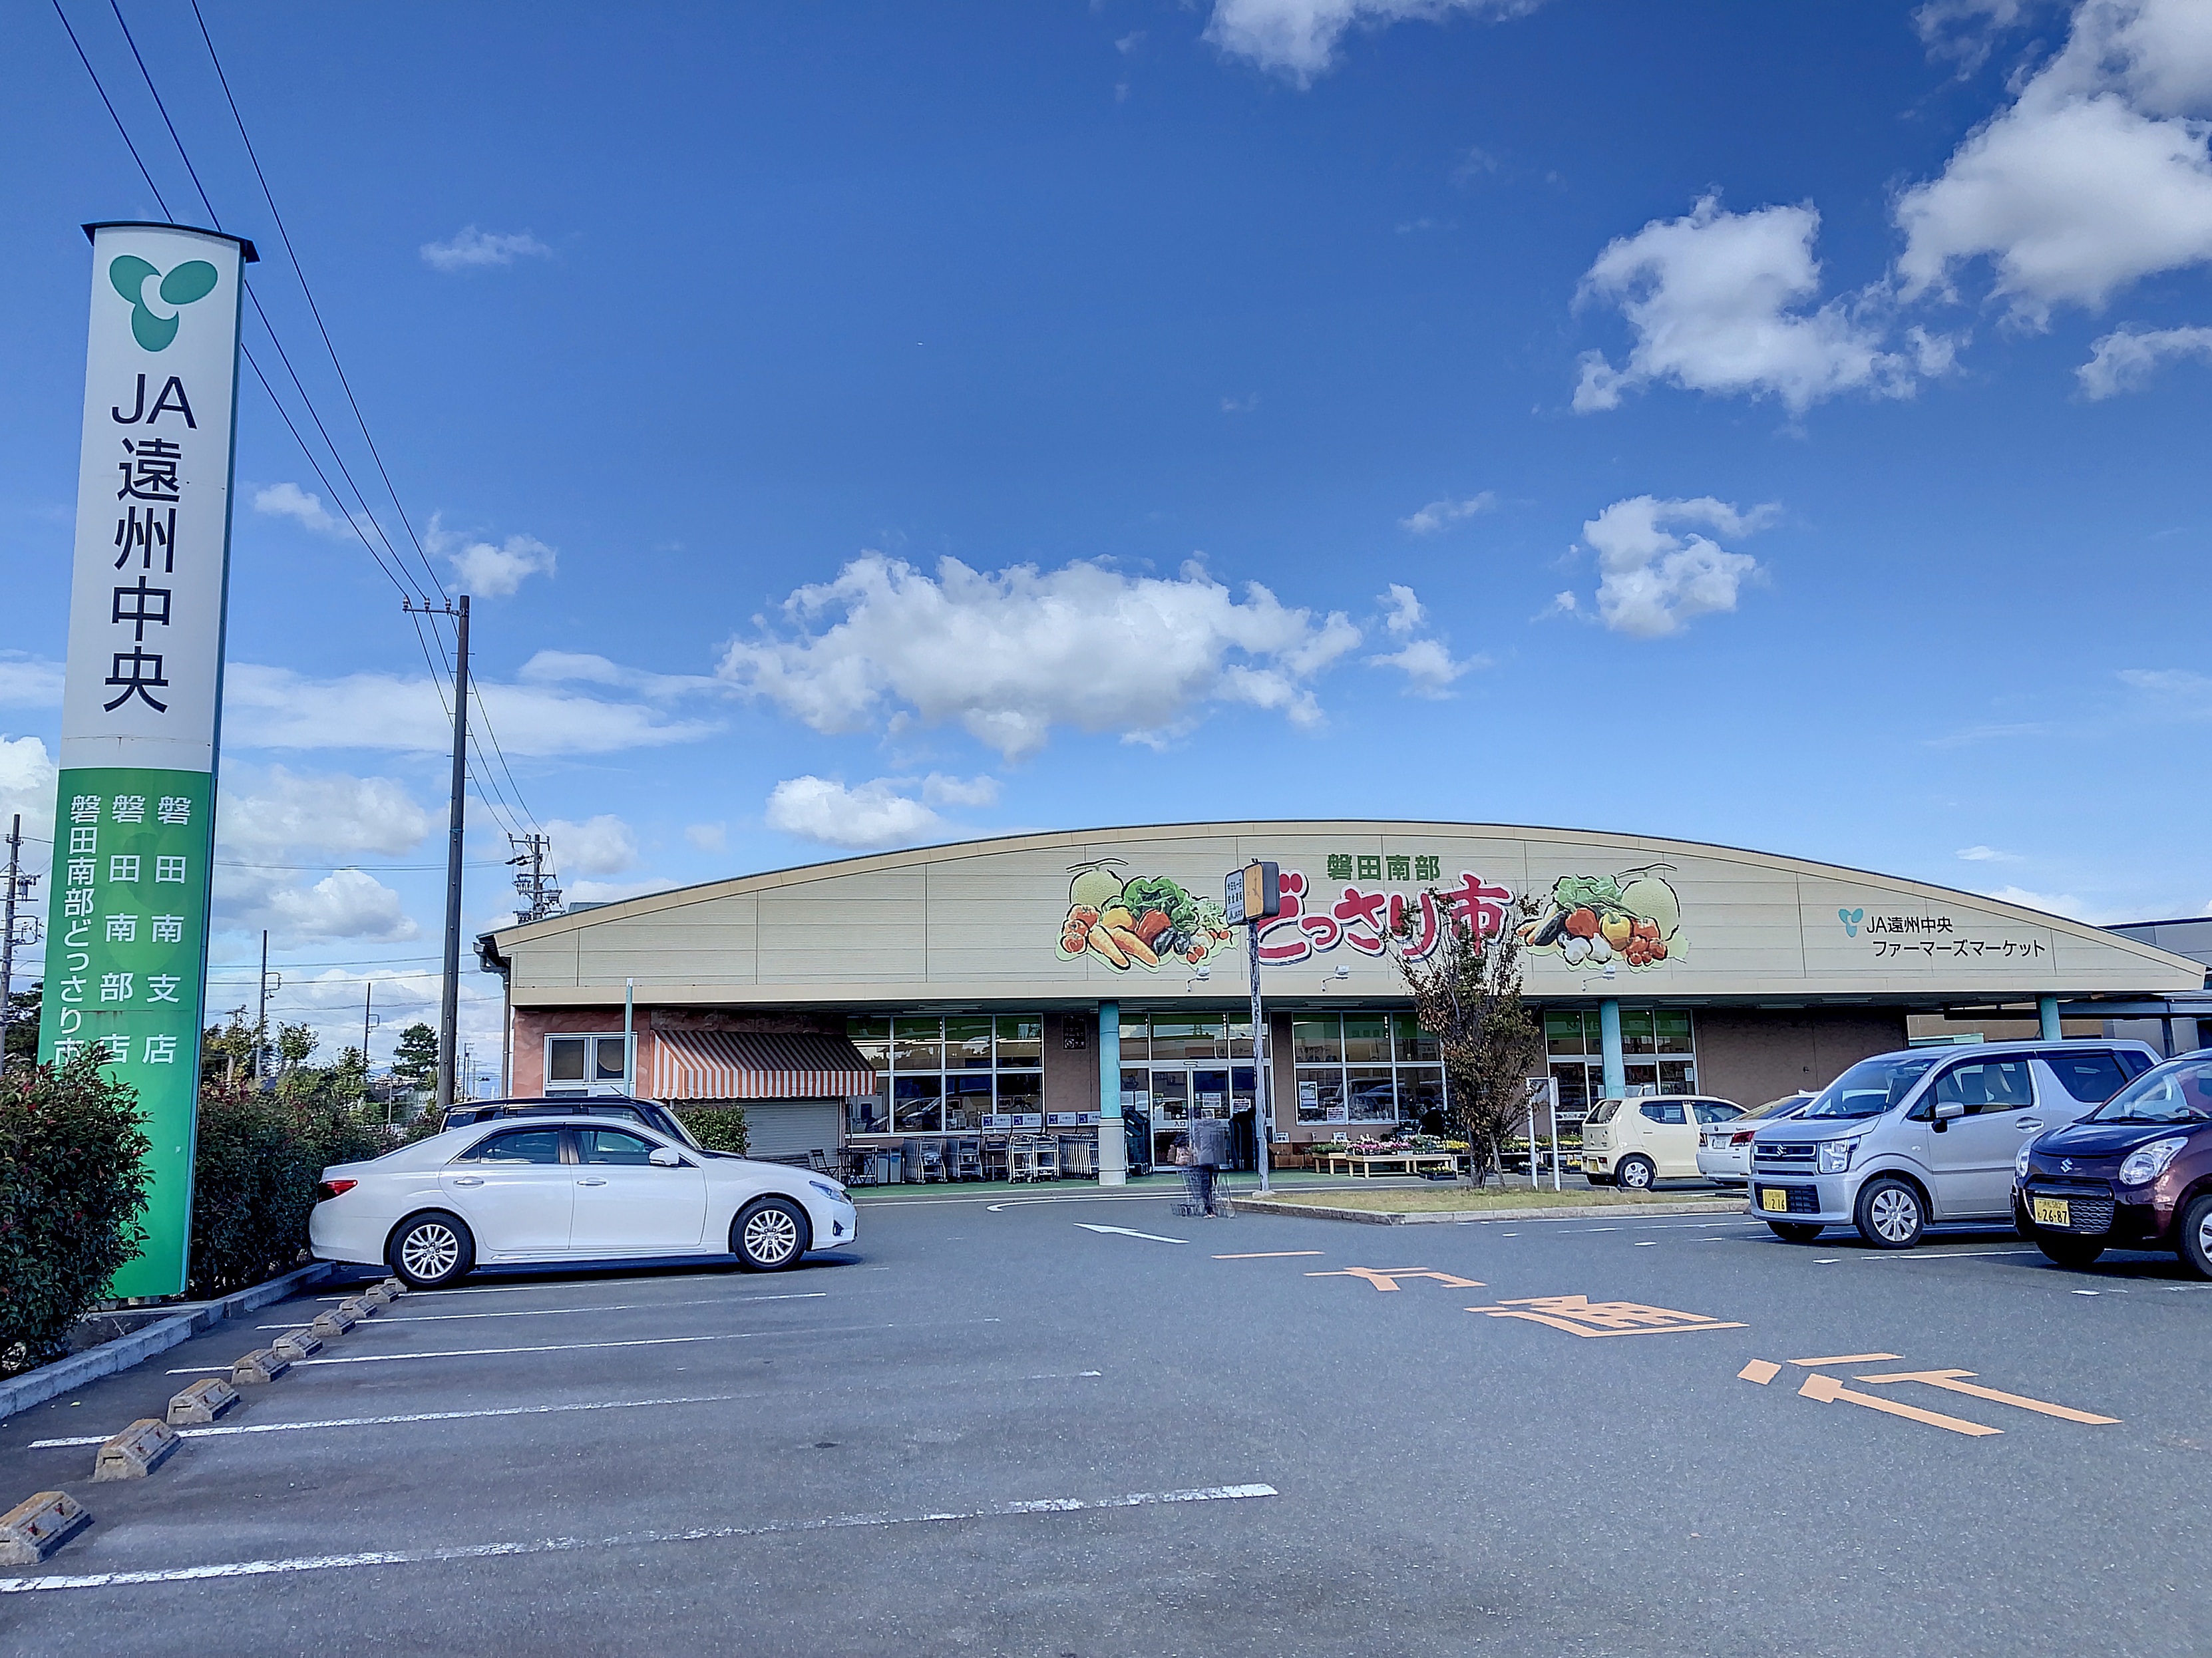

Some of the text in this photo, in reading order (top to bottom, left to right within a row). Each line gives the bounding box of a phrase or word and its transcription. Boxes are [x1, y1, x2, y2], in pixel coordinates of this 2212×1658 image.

[102, 373, 198, 714] JA遠州中央
[1327, 854, 1441, 882] 磐田南部
[142, 795, 192, 1065] 磐田南支店
[1257, 872, 1513, 960] どっさり市
[1866, 916, 1954, 933] JA遠州中央
[1872, 939, 2046, 957] ファーマーズマーケット
[1211, 1249, 2121, 1437] 一方通行
